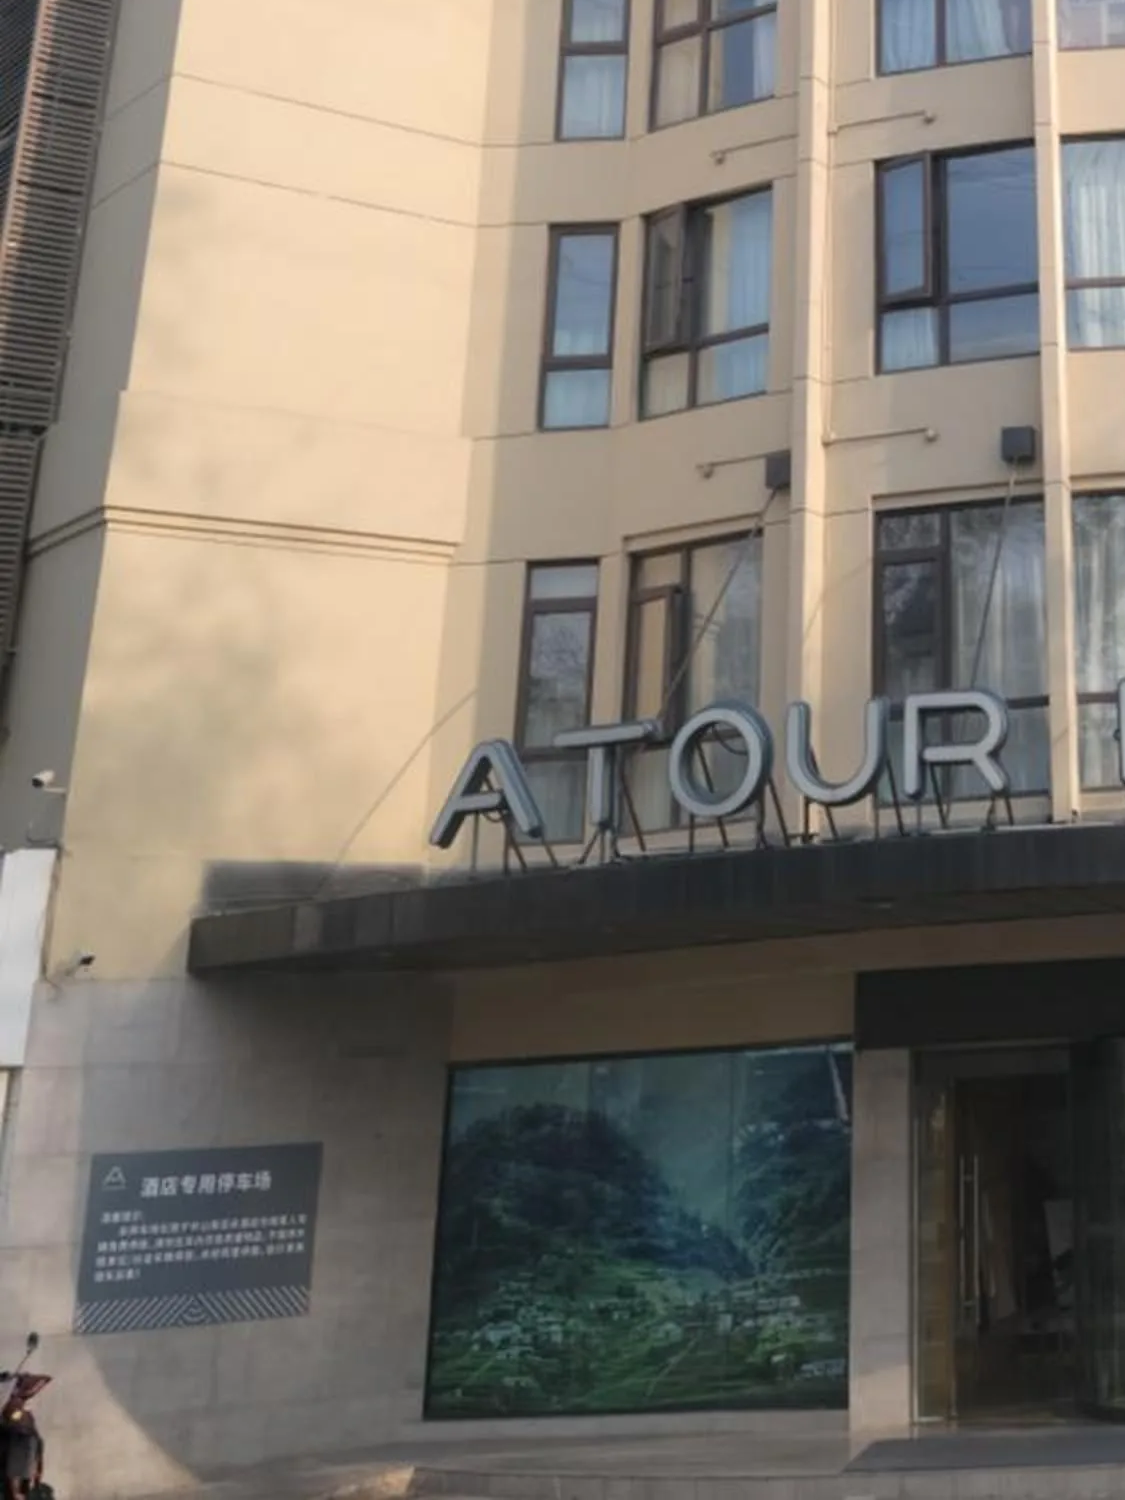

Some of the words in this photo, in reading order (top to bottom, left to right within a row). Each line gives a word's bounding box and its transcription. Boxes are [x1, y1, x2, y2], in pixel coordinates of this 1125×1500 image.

[429, 690, 1009, 849] ATOUR
[140, 1170, 273, 1198] 酒店专用停车场
